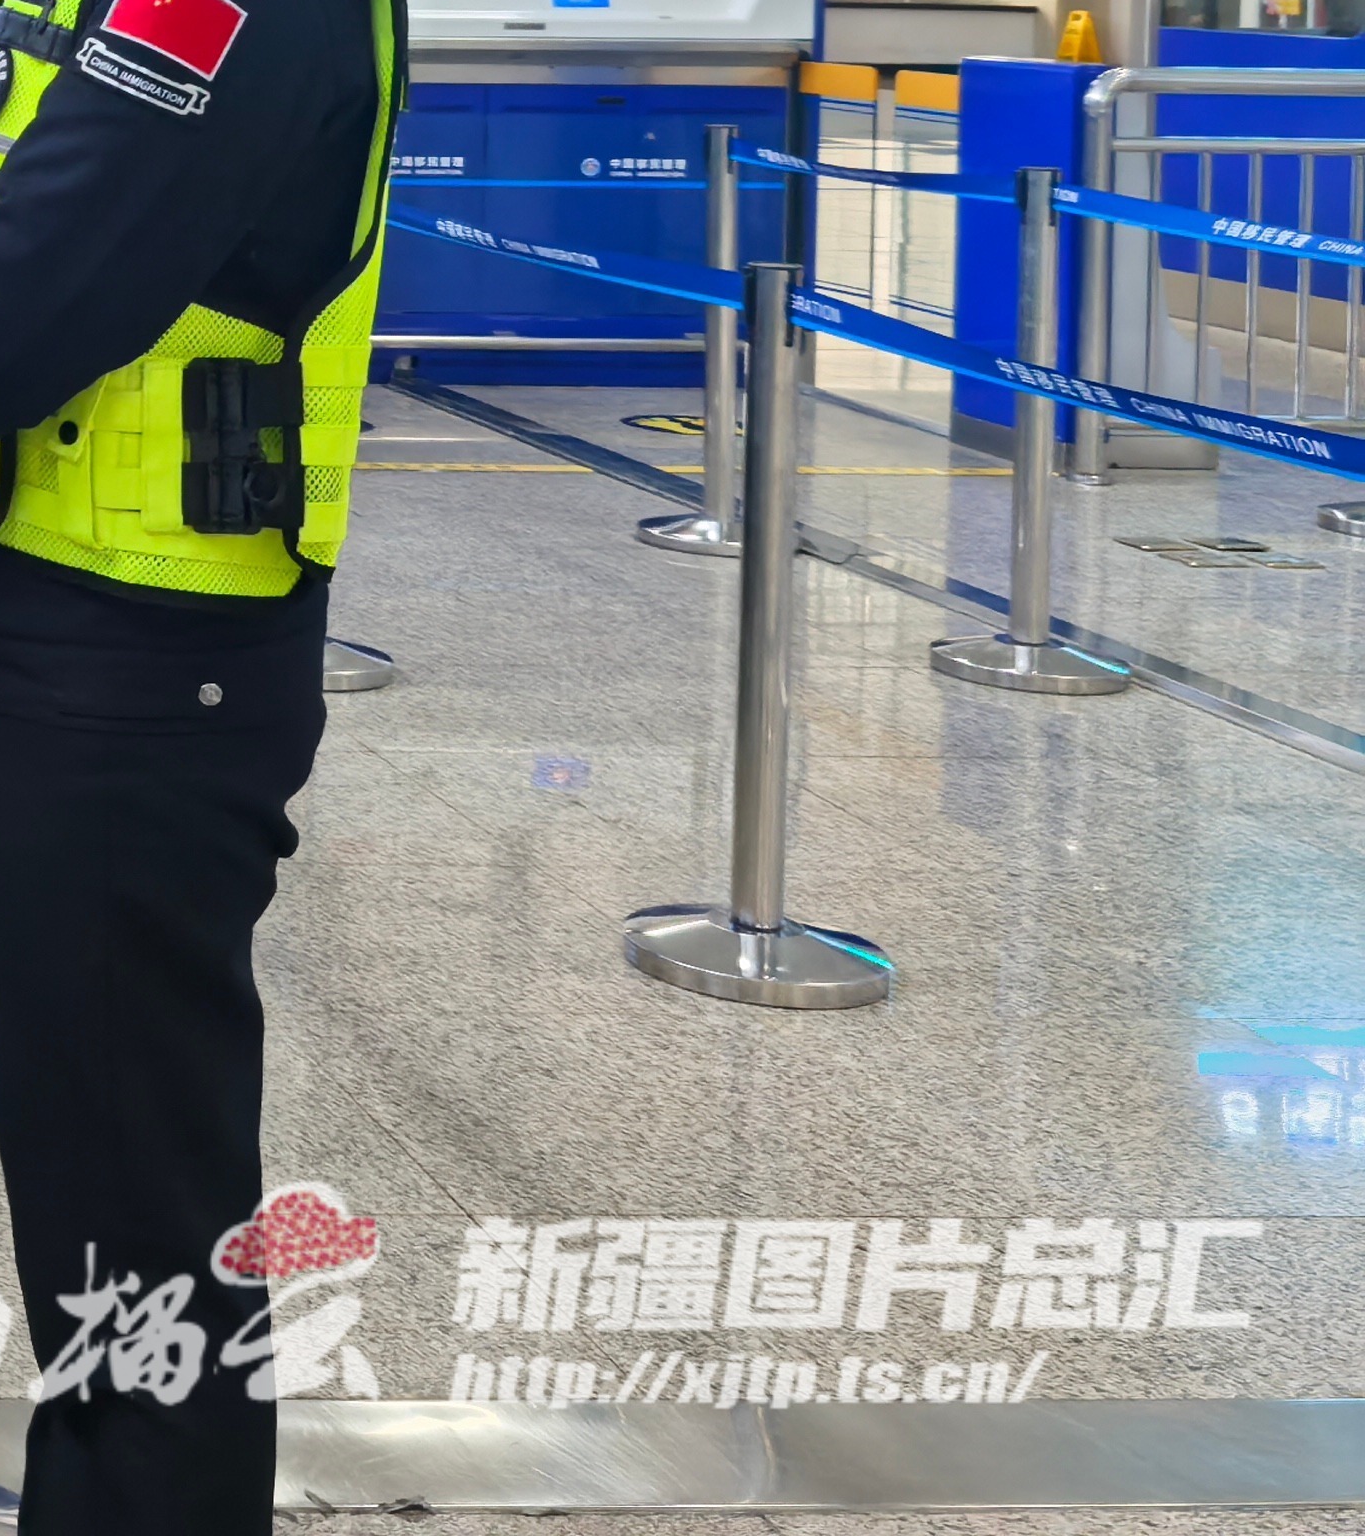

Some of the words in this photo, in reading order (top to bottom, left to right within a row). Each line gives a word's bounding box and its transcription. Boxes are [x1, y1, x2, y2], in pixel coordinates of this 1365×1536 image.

[90, 56, 119, 76] CHINA
[119, 70, 186, 106] IMMIGRATION
[1212, 217, 1312, 249] 中国移民管理
[1318, 240, 1364, 255] CHINA
[995, 357, 1121, 409] 中国移民管理
[1130, 397, 1192, 426] CHINA
[1192, 412, 1333, 460] IMMIGRATION
